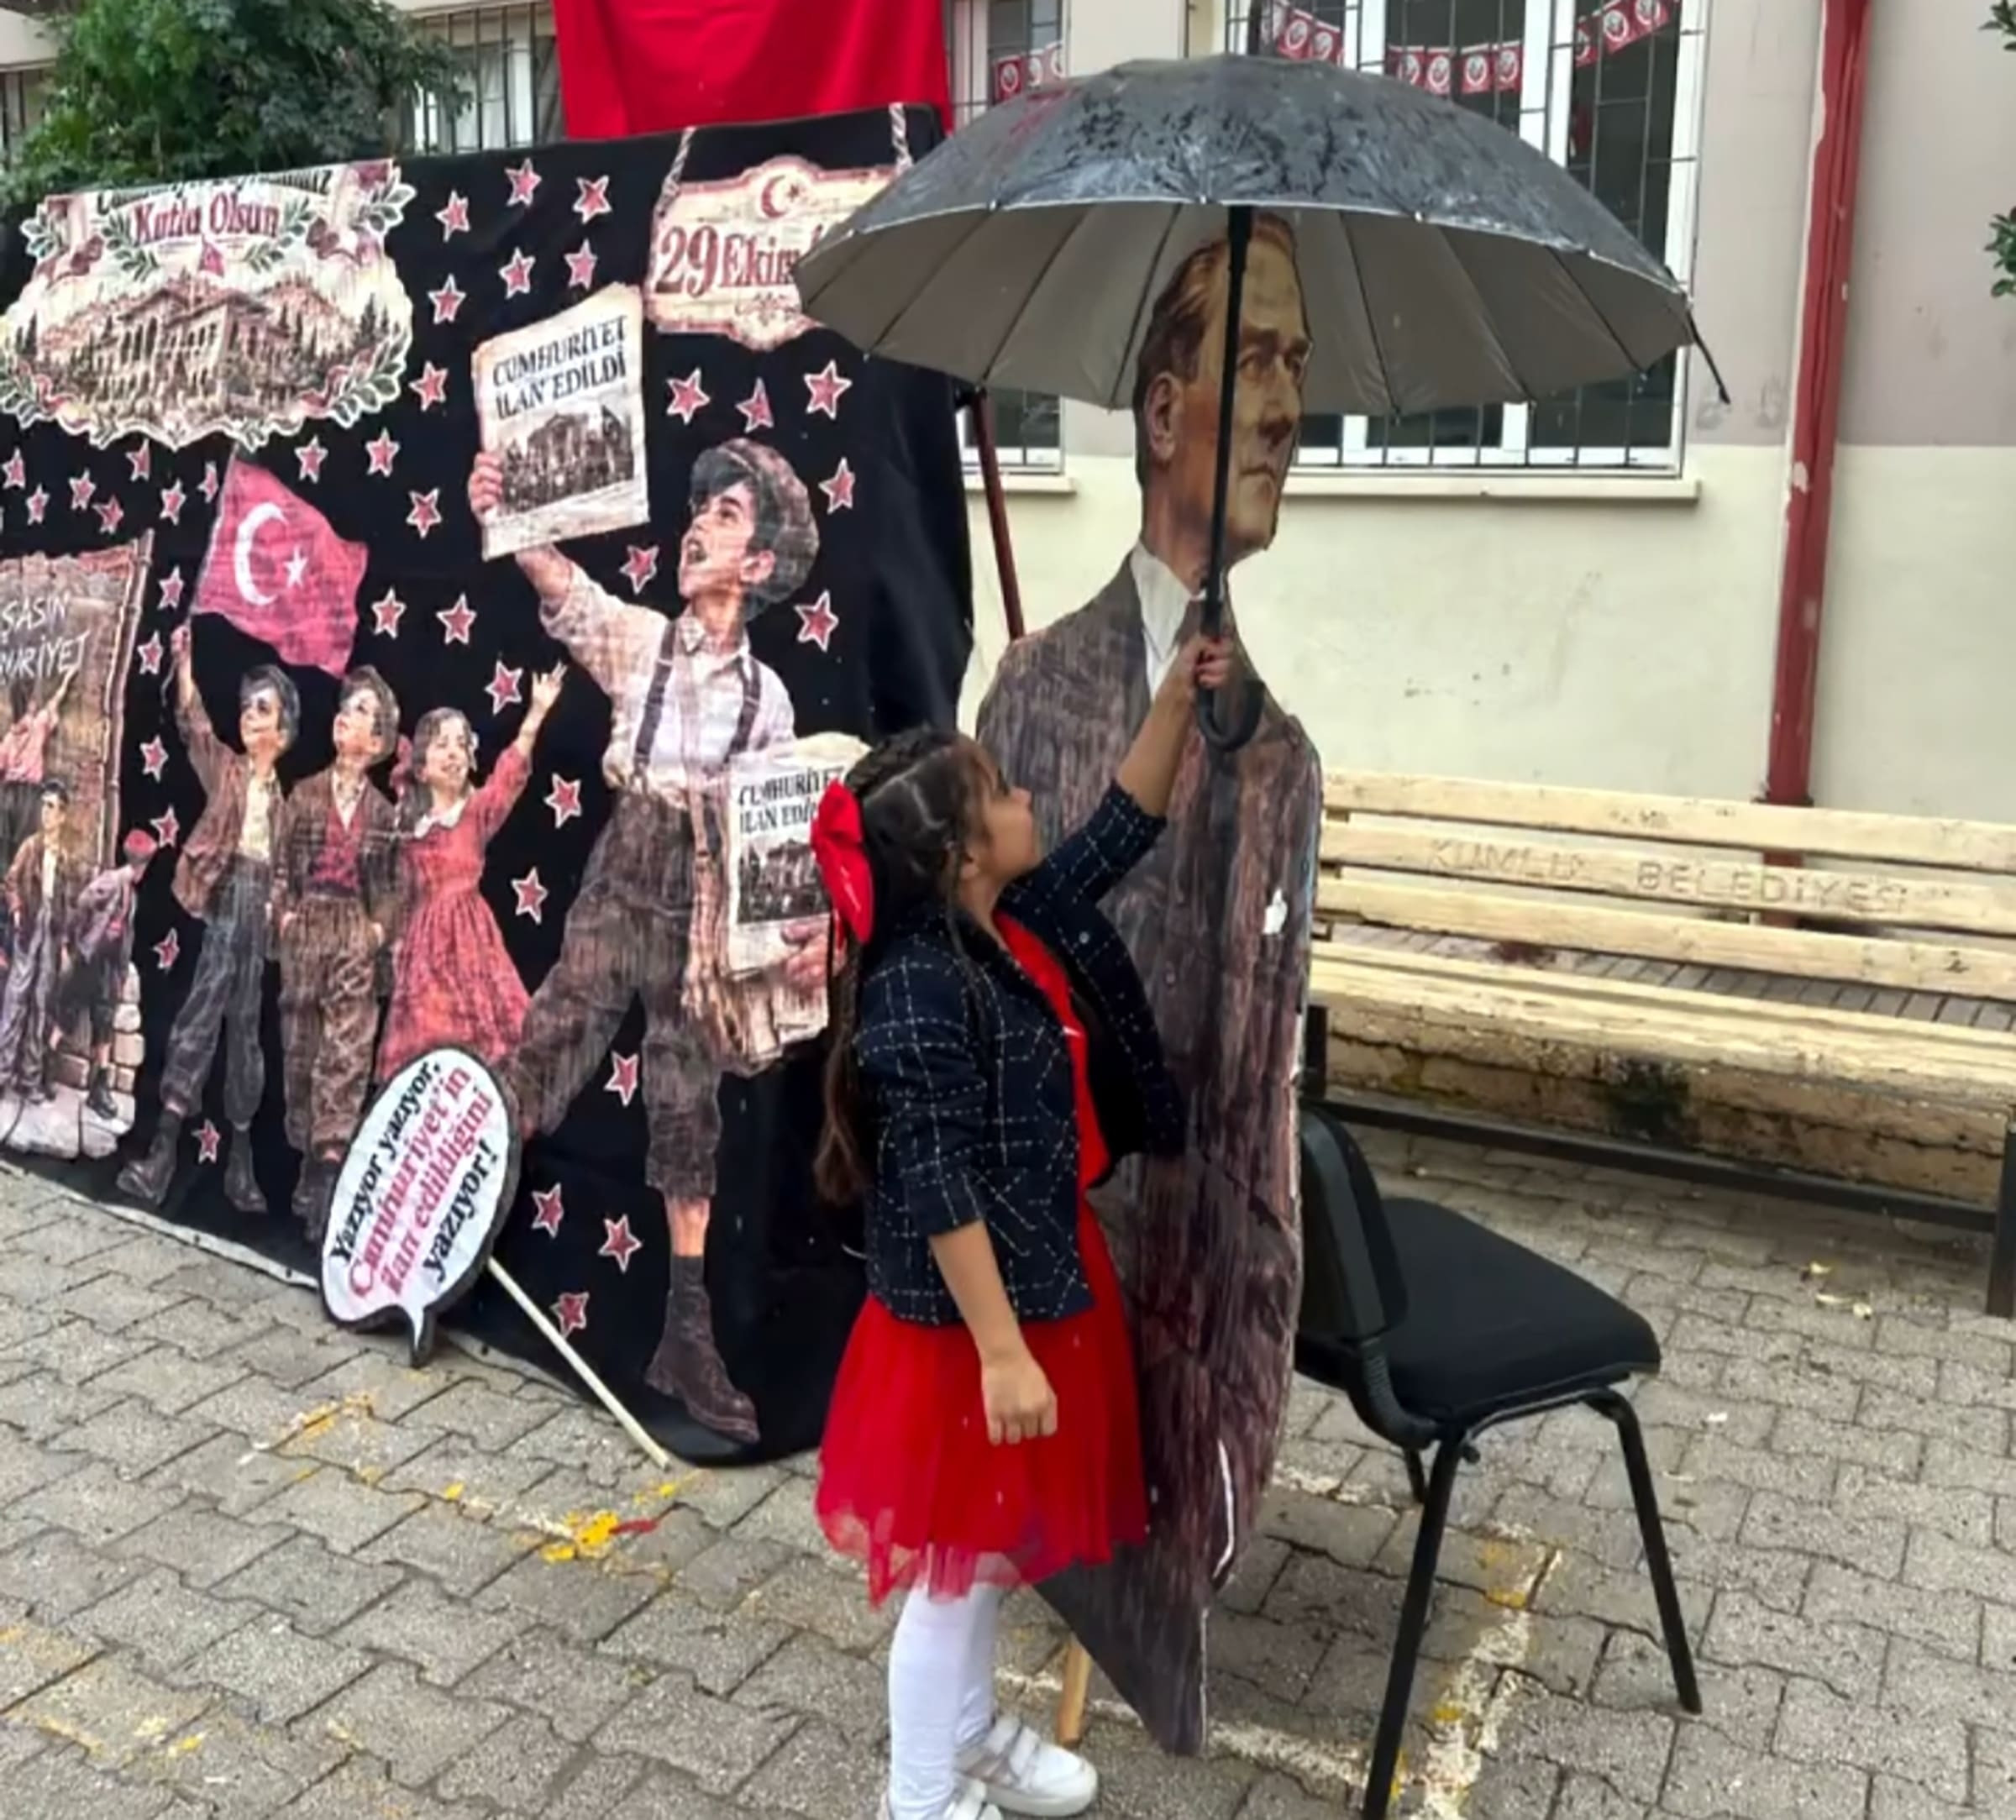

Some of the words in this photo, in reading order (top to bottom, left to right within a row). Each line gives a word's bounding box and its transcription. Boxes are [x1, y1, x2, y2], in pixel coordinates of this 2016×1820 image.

[210, 191, 280, 238] Olsun
[655, 224, 718, 297] 29
[423, 1138, 498, 1282] yazıyor!
